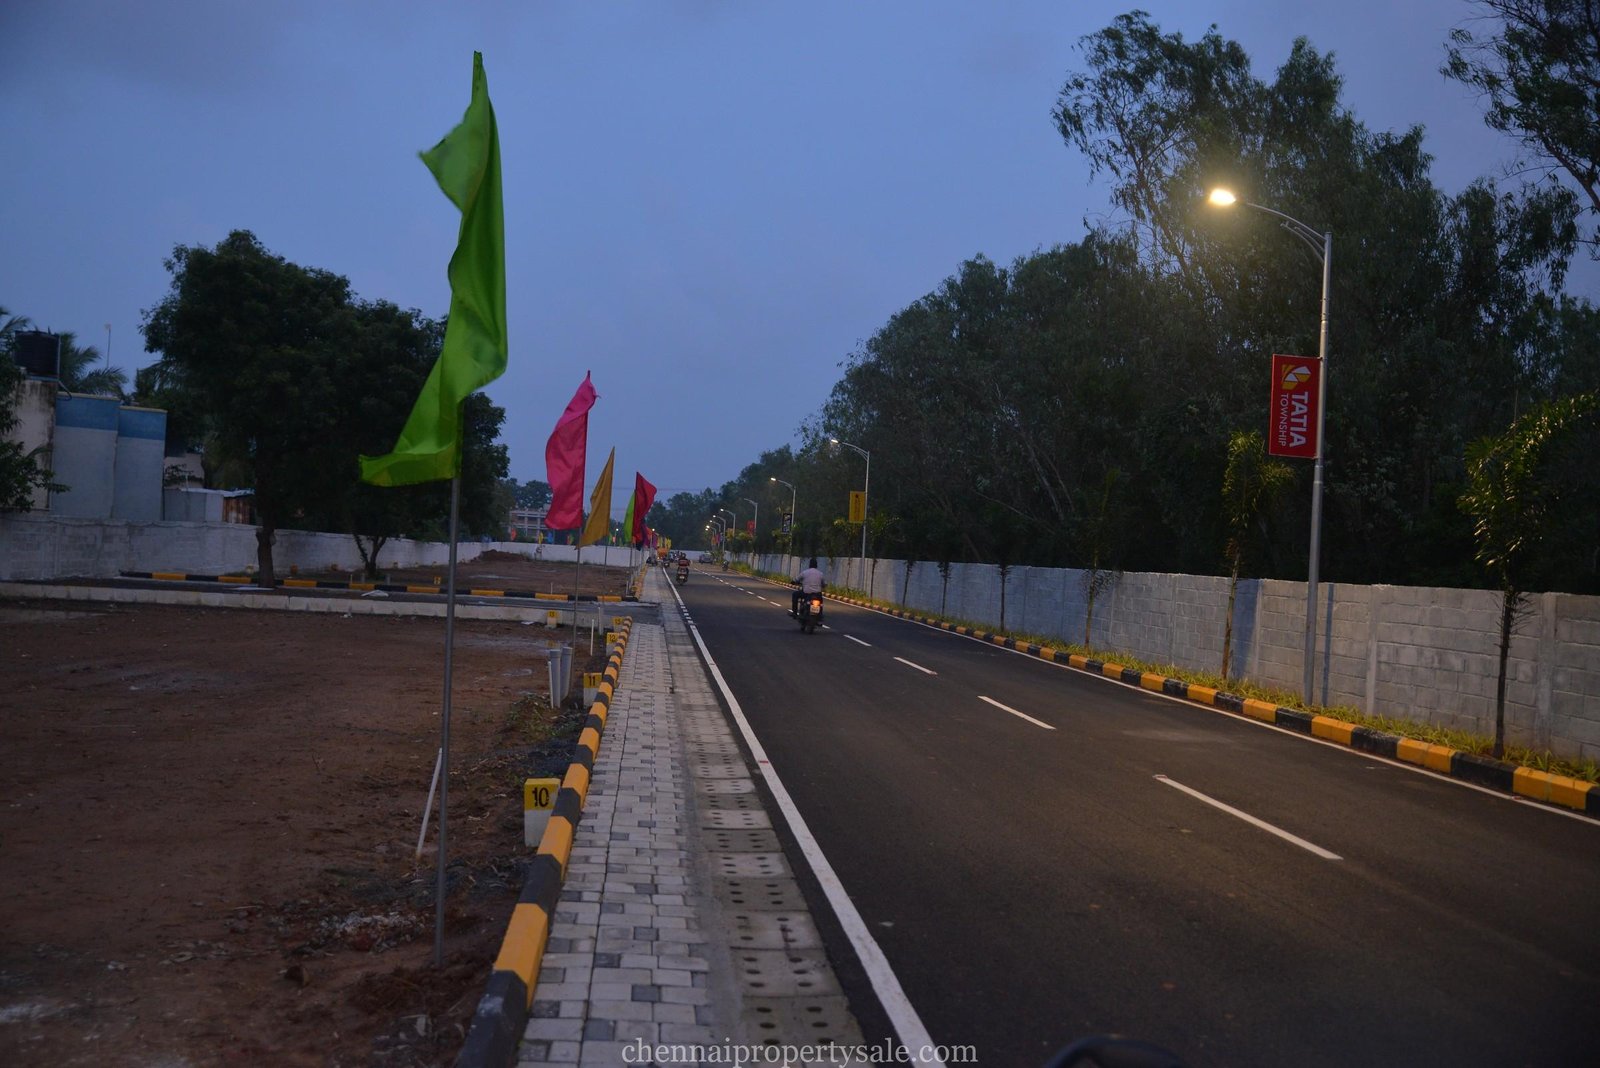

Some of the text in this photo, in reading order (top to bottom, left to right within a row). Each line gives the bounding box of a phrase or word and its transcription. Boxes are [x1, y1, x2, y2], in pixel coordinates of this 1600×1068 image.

[1278, 393, 1289, 447] TOWNSHIP
[1289, 391, 1309, 448] TATIA
[588, 675, 596, 686] 11
[532, 787, 549, 808] 10
